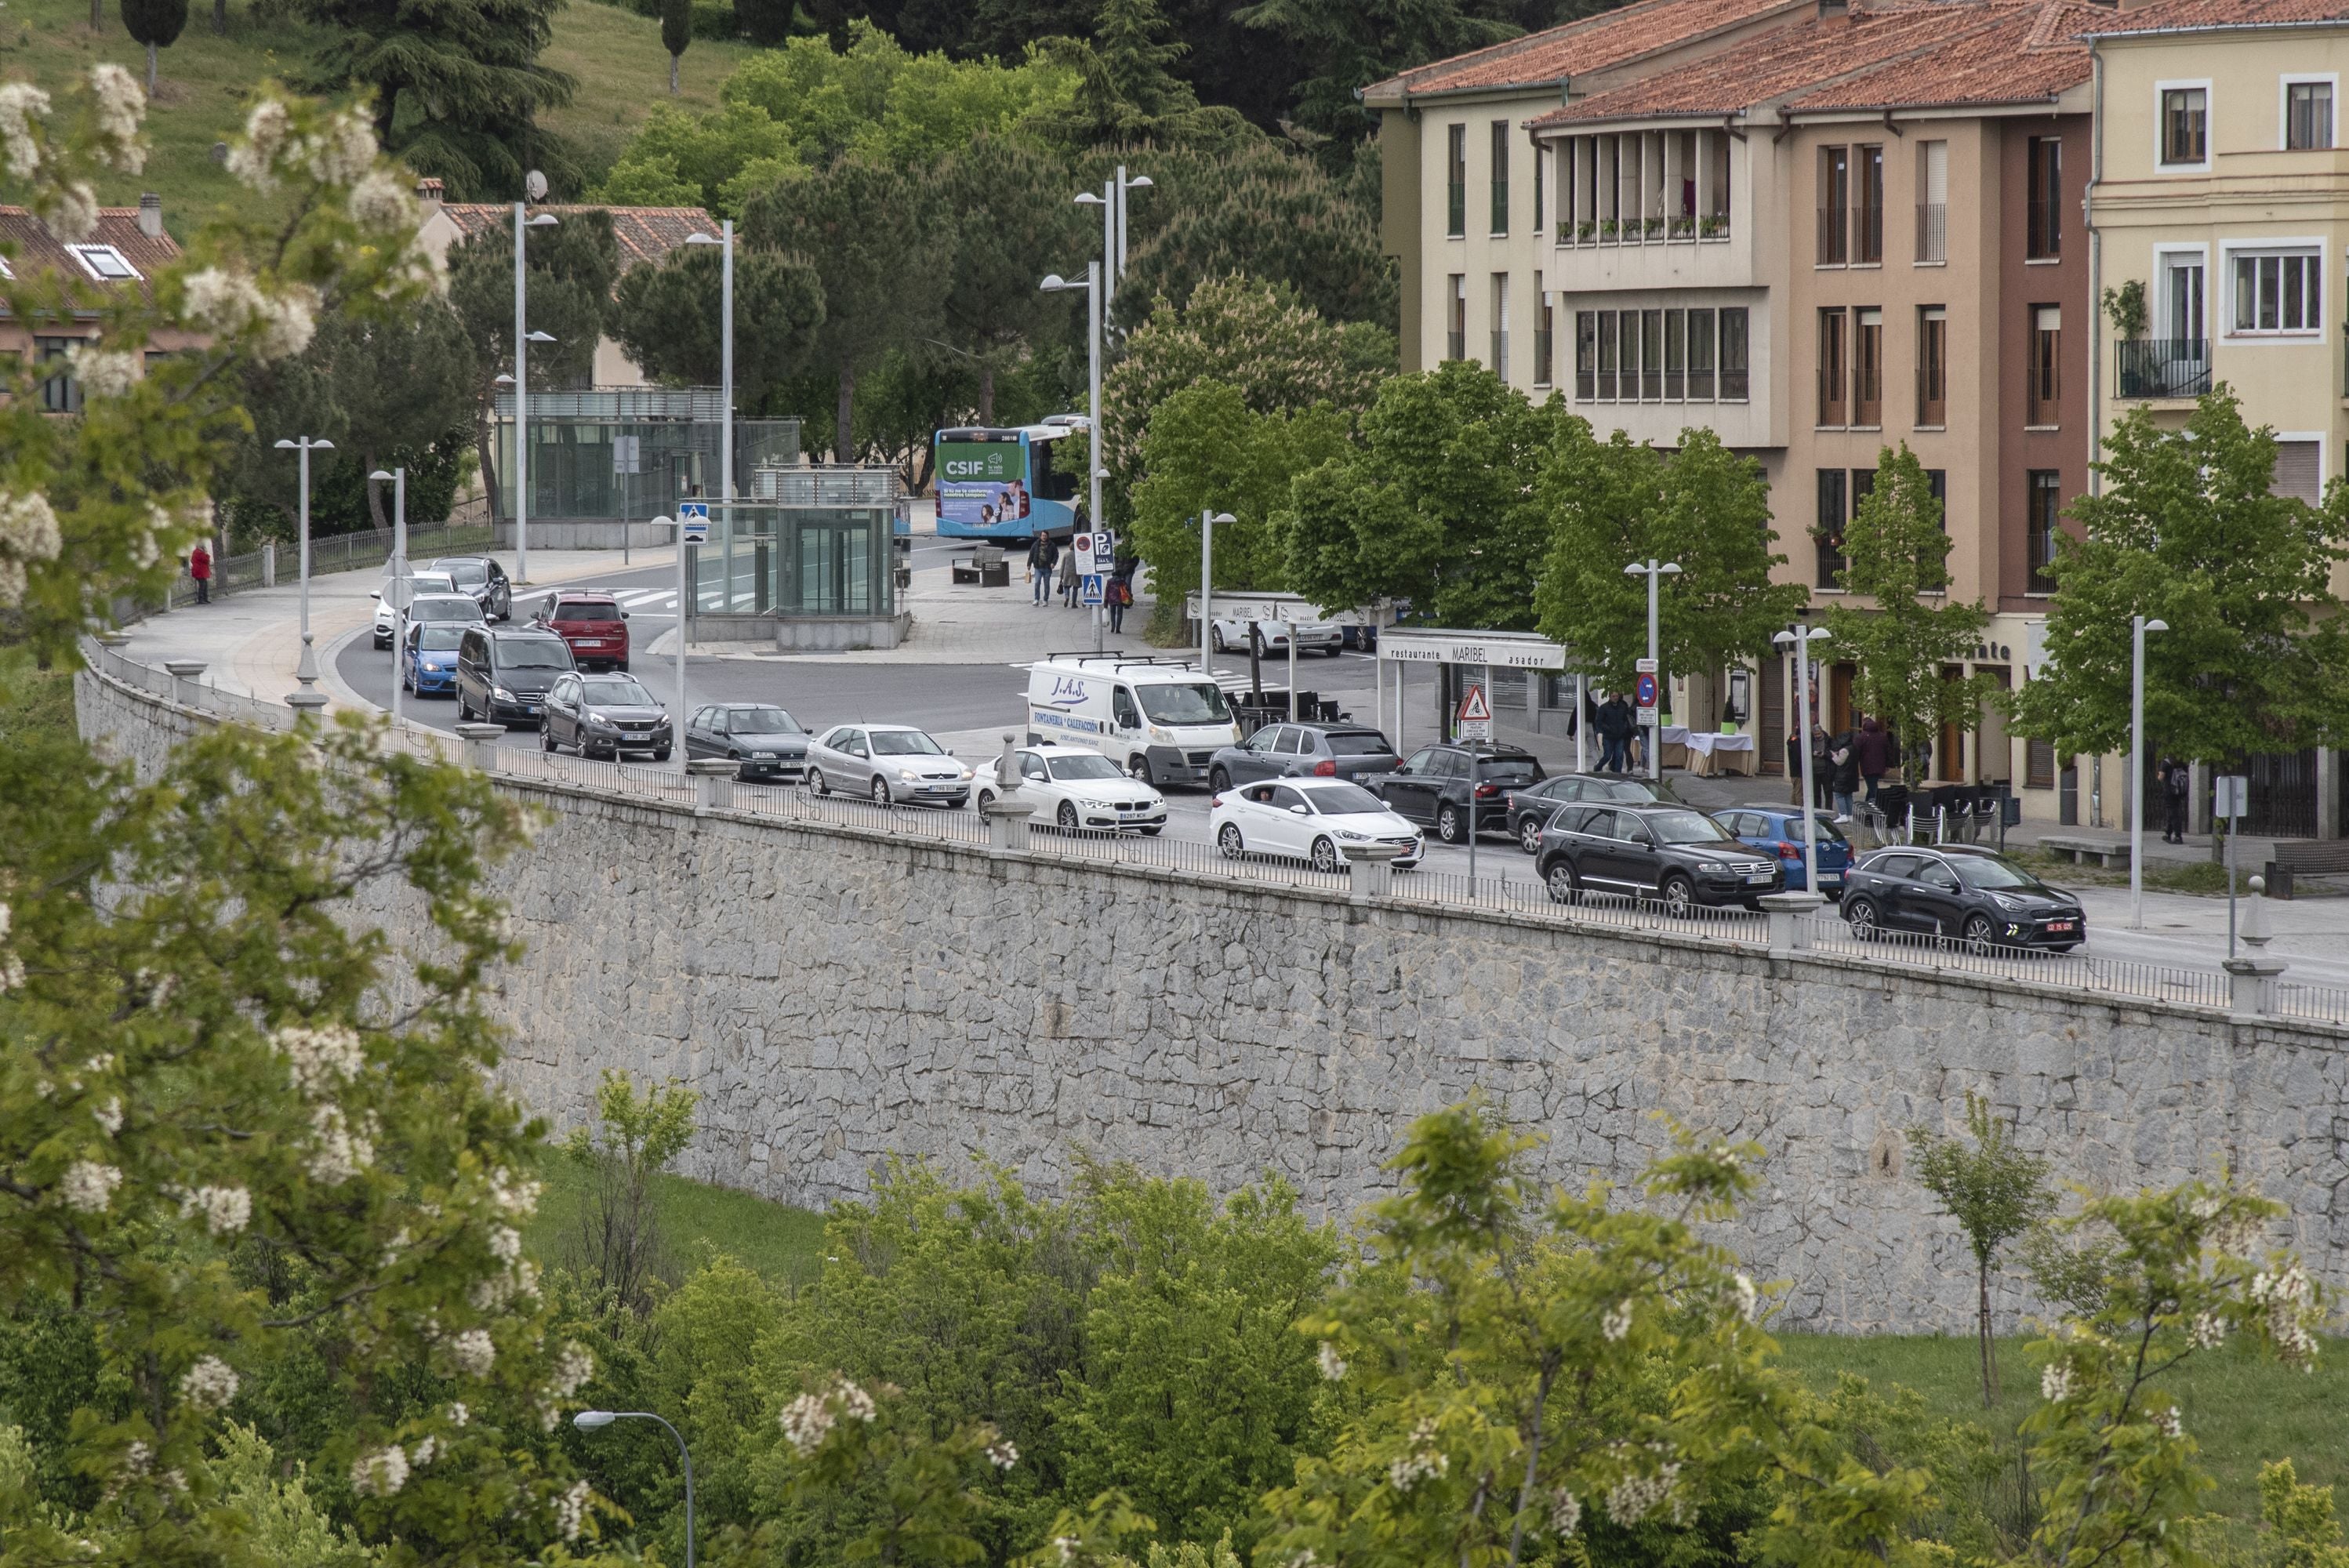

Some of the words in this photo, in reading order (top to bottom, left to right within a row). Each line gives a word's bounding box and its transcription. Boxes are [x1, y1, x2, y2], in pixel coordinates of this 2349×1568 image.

[946, 461, 983, 475] CSIF
[1095, 533, 1108, 555] P
[1233, 607, 1254, 618] MARIBEL
[1391, 649, 1440, 659] restaurante
[1452, 646, 1487, 662] MARIBEL
[1509, 655, 1544, 666] asador
[1051, 677, 1085, 697] J.A.S.
[1034, 712, 1063, 727] FONTANERIA
[1066, 717, 1098, 734] CALEFACCIÓN
